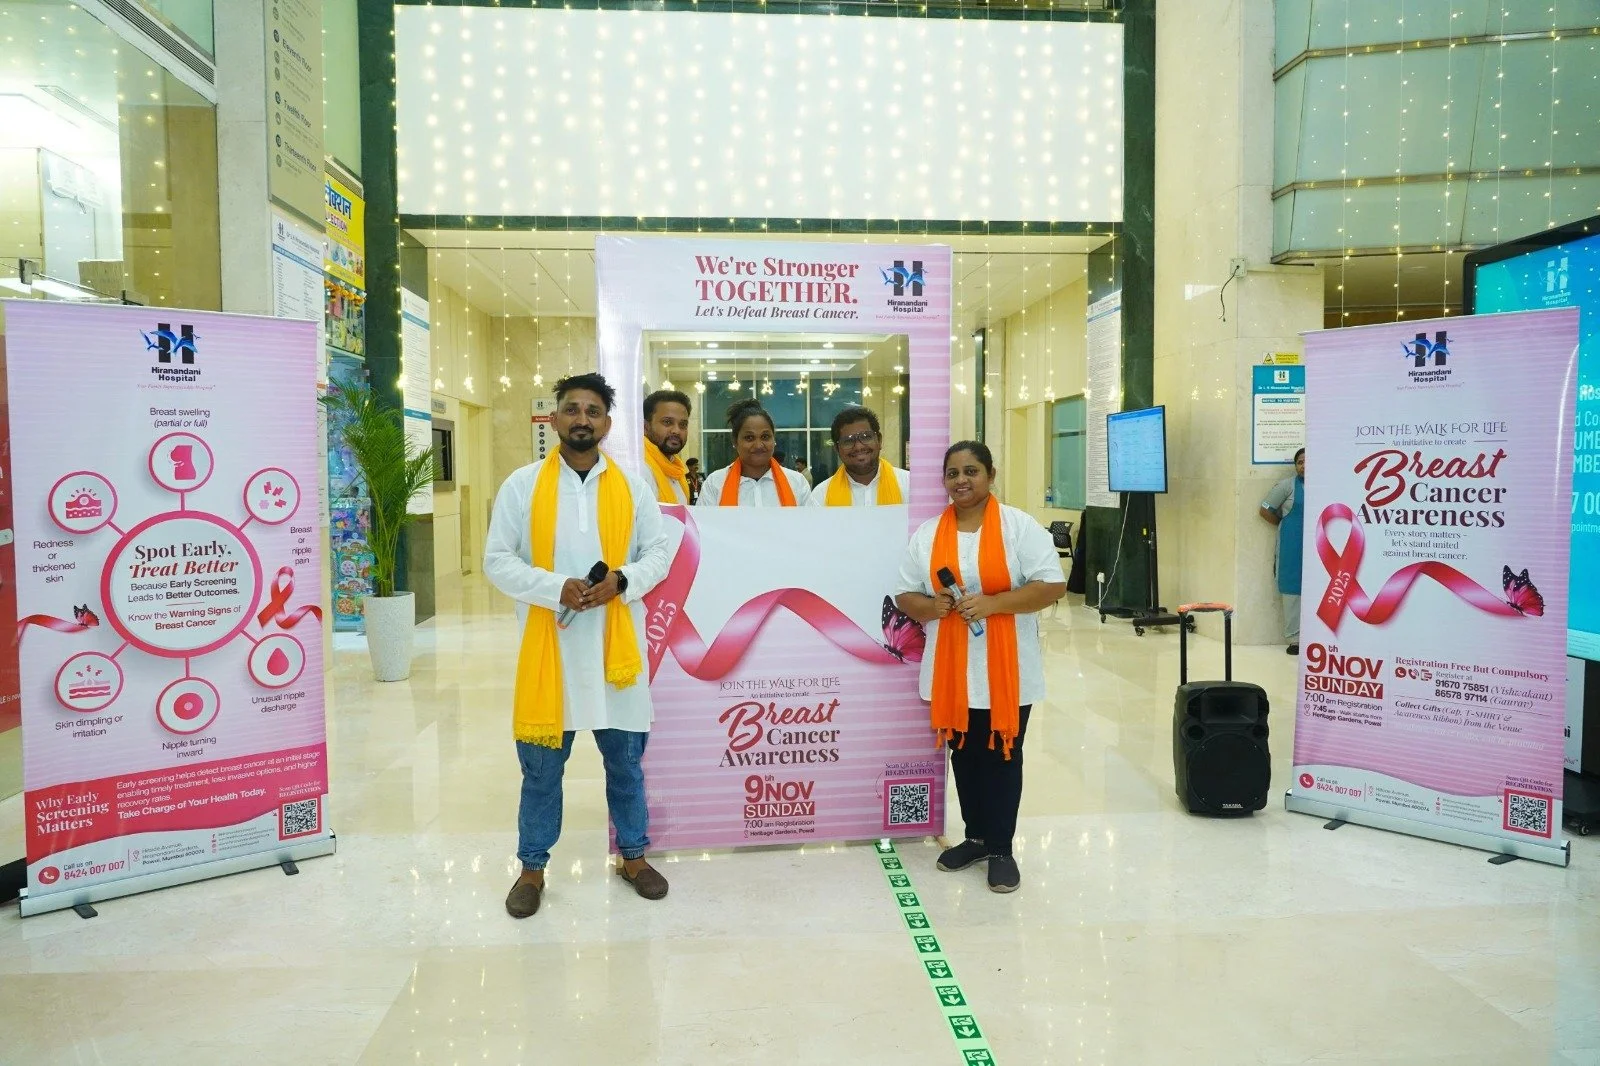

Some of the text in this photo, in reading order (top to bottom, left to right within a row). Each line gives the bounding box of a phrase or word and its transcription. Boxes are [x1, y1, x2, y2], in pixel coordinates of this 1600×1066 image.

[694, 255, 859, 282] We're Stronger
[695, 280, 858, 304] TOGETHER.
[695, 306, 858, 320] Let's Defeat Breast Cancer.
[152, 366, 201, 375] Hiranandani
[158, 374, 196, 382] Hospital
[1408, 368, 1452, 376] Hiranandani
[150, 407, 210, 418] Breast swelling
[154, 419, 182, 428] (partial
[194, 419, 208, 428] full)
[1356, 420, 1508, 437] JOIN THE WALK FOR LIFE
[1354, 448, 1507, 507] Breast
[1410, 482, 1506, 503] Cancer
[1357, 504, 1505, 528] Awareness
[1384, 529, 1460, 538] Every story matters
[34, 540, 74, 549] Redness
[135, 540, 232, 562] Spot Early.
[292, 546, 312, 555] nipple
[1392, 540, 1459, 549] let's stand united
[1382, 550, 1468, 560] against breast cancer.
[32, 562, 76, 572] thickened
[129, 560, 239, 578] Treat Better
[46, 574, 64, 584] skin
[130, 577, 237, 591] Because Early Screening
[166, 591, 192, 600] Better
[194, 588, 240, 598] Outcomes.
[1328, 570, 1350, 606] 2025
[128, 614, 152, 622] Know
[169, 610, 206, 618] Warning
[208, 606, 232, 616] Signs
[155, 619, 216, 630] Breast Cancer
[646, 598, 676, 654] 2025
[1328, 654, 1384, 680] NOV
[1395, 656, 1550, 682] Registration Free But Compulsory
[1436, 670, 1464, 680] Register
[720, 677, 840, 690] JOIN THE WALK FOR LIFE
[1306, 676, 1381, 698] SUNDAY
[1436, 680, 1552, 702] 91670 75851 (Vishwakant)
[252, 691, 306, 704] Unusual nipple
[1304, 692, 1324, 702] 7:00
[1338, 700, 1382, 711] Registration
[1435, 689, 1534, 709] 86578 97114 (Gaurav)
[261, 703, 296, 713] discharge
[55, 714, 124, 730] Skin dimpling or
[718, 698, 840, 752] Breast
[1312, 712, 1336, 720] Heritage
[1338, 716, 1363, 724] Gardens,
[1394, 710, 1430, 720] Awareness
[1432, 714, 1462, 725] Ribbon)
[1463, 718, 1482, 728] from
[1484, 722, 1496, 730] the
[1498, 724, 1522, 733] Venue
[72, 728, 106, 738] irritation
[766, 728, 840, 746] Cancer
[162, 736, 217, 751] Nipple turning
[176, 748, 204, 758] inward
[718, 748, 840, 768] Awareness
[116, 781, 136, 790] Early
[138, 774, 174, 786] screening
[176, 771, 196, 780] helps
[197, 767, 220, 776] detect
[220, 764, 242, 773] breast
[244, 760, 266, 769] cancer
[302, 752, 320, 760] stage
[766, 781, 815, 802] NOV
[1316, 783, 1362, 797] 8424 007 007
[36, 792, 100, 810] Why Early
[118, 788, 266, 819] Take Charge of Your Health Today.
[36, 802, 110, 823] Screening
[746, 802, 812, 818] SUNDAY
[38, 818, 93, 836] Matters
[744, 820, 762, 828] 7:00
[775, 820, 815, 828] Registration
[64, 860, 125, 880] 8424 007 007
